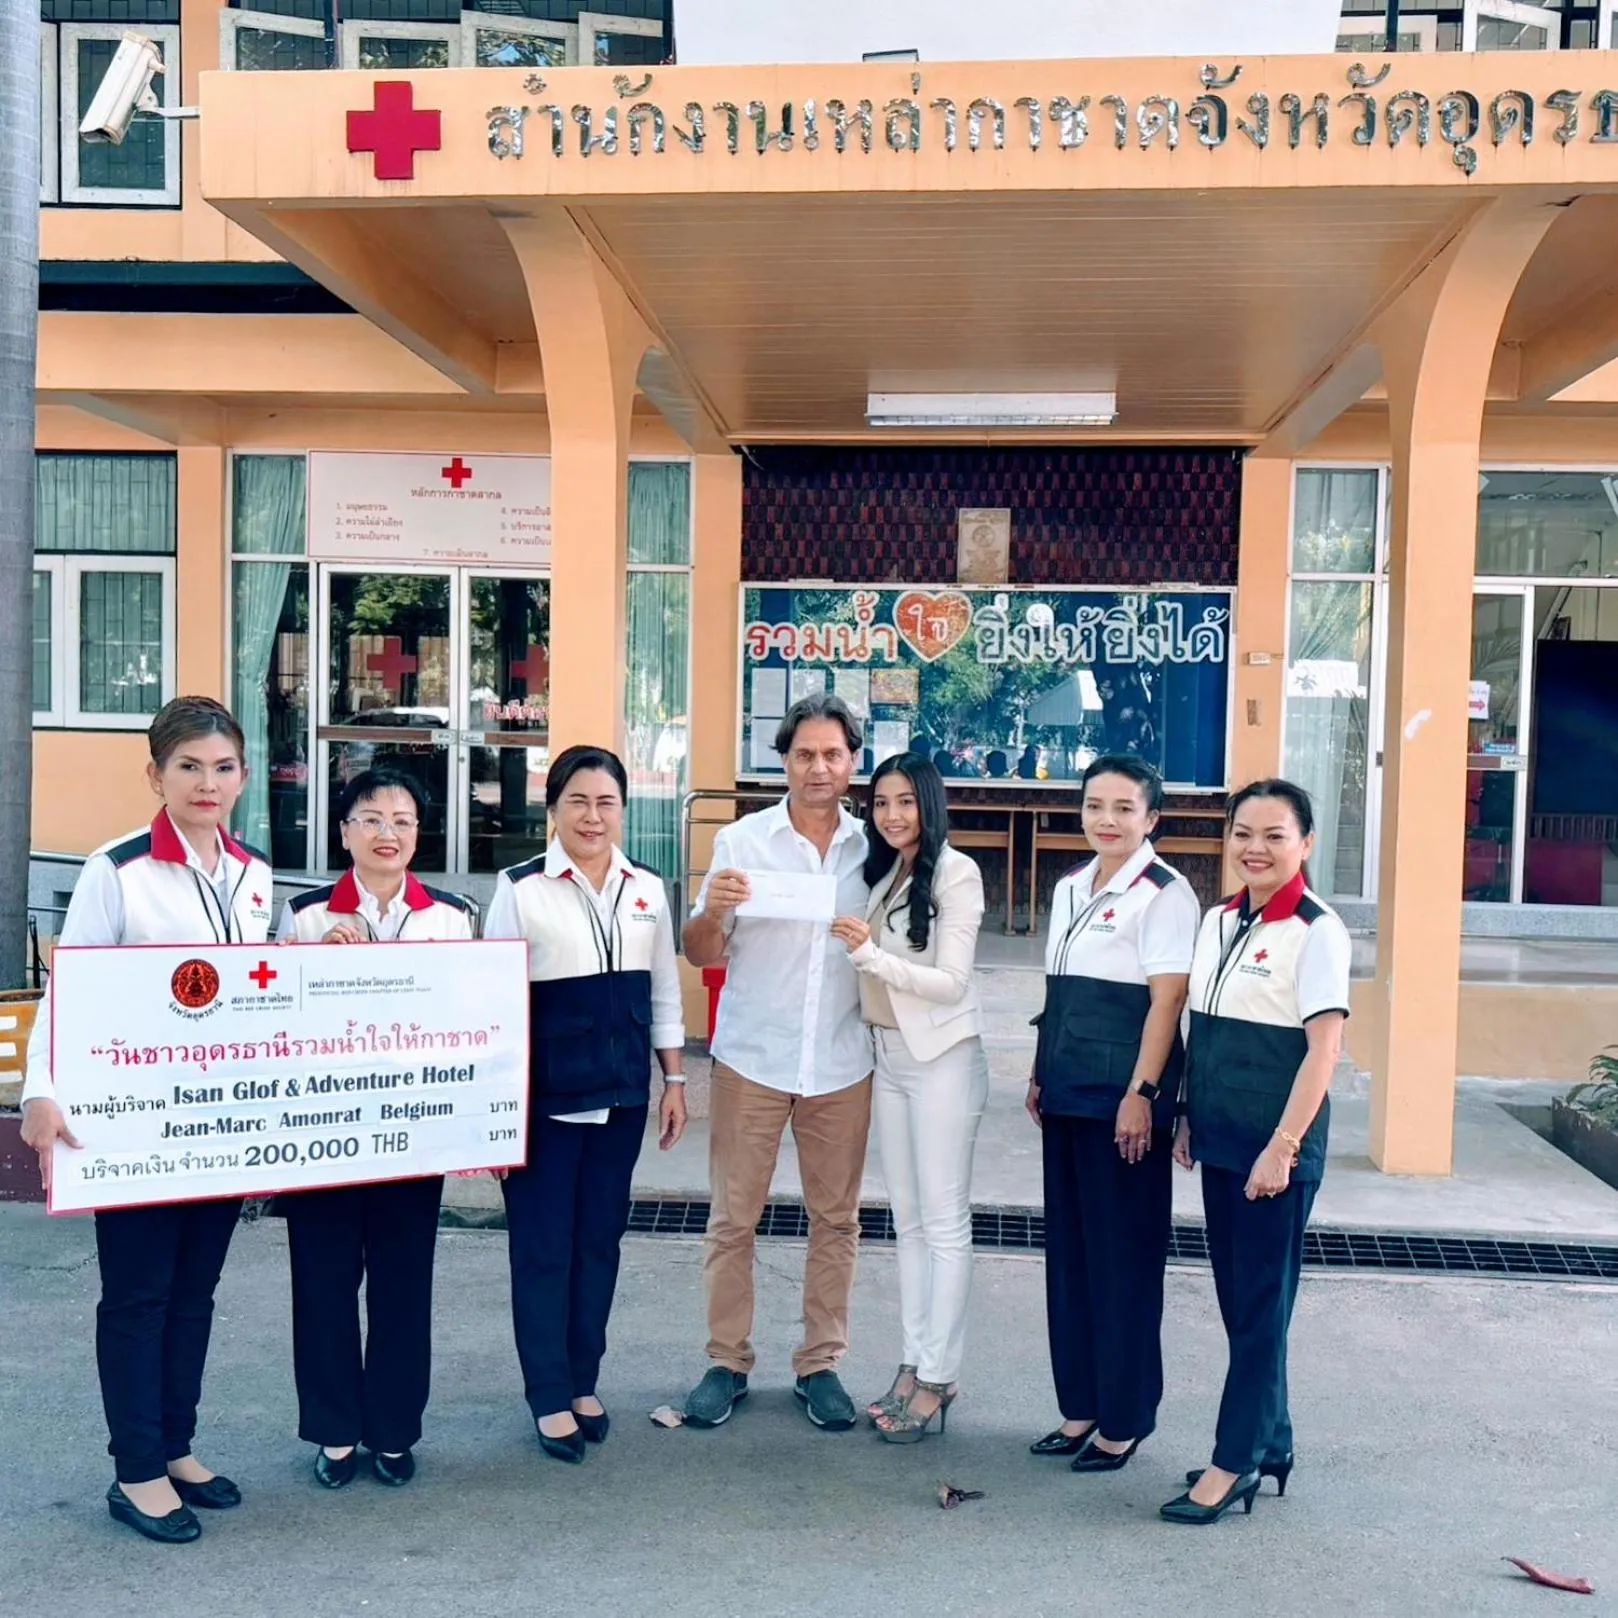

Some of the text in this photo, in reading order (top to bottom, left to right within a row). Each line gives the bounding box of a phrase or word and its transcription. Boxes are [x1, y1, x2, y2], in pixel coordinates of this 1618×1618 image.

[69, 1064, 475, 1119] นามผู้บริจาค Isan Glof & Adventure Hotel
[160, 1098, 518, 1139] Jean-Marc Amonrat Belgium บาท
[244, 1137, 360, 1167] 200,000
[371, 1132, 409, 1154] THB
[489, 1126, 517, 1142] บาท
